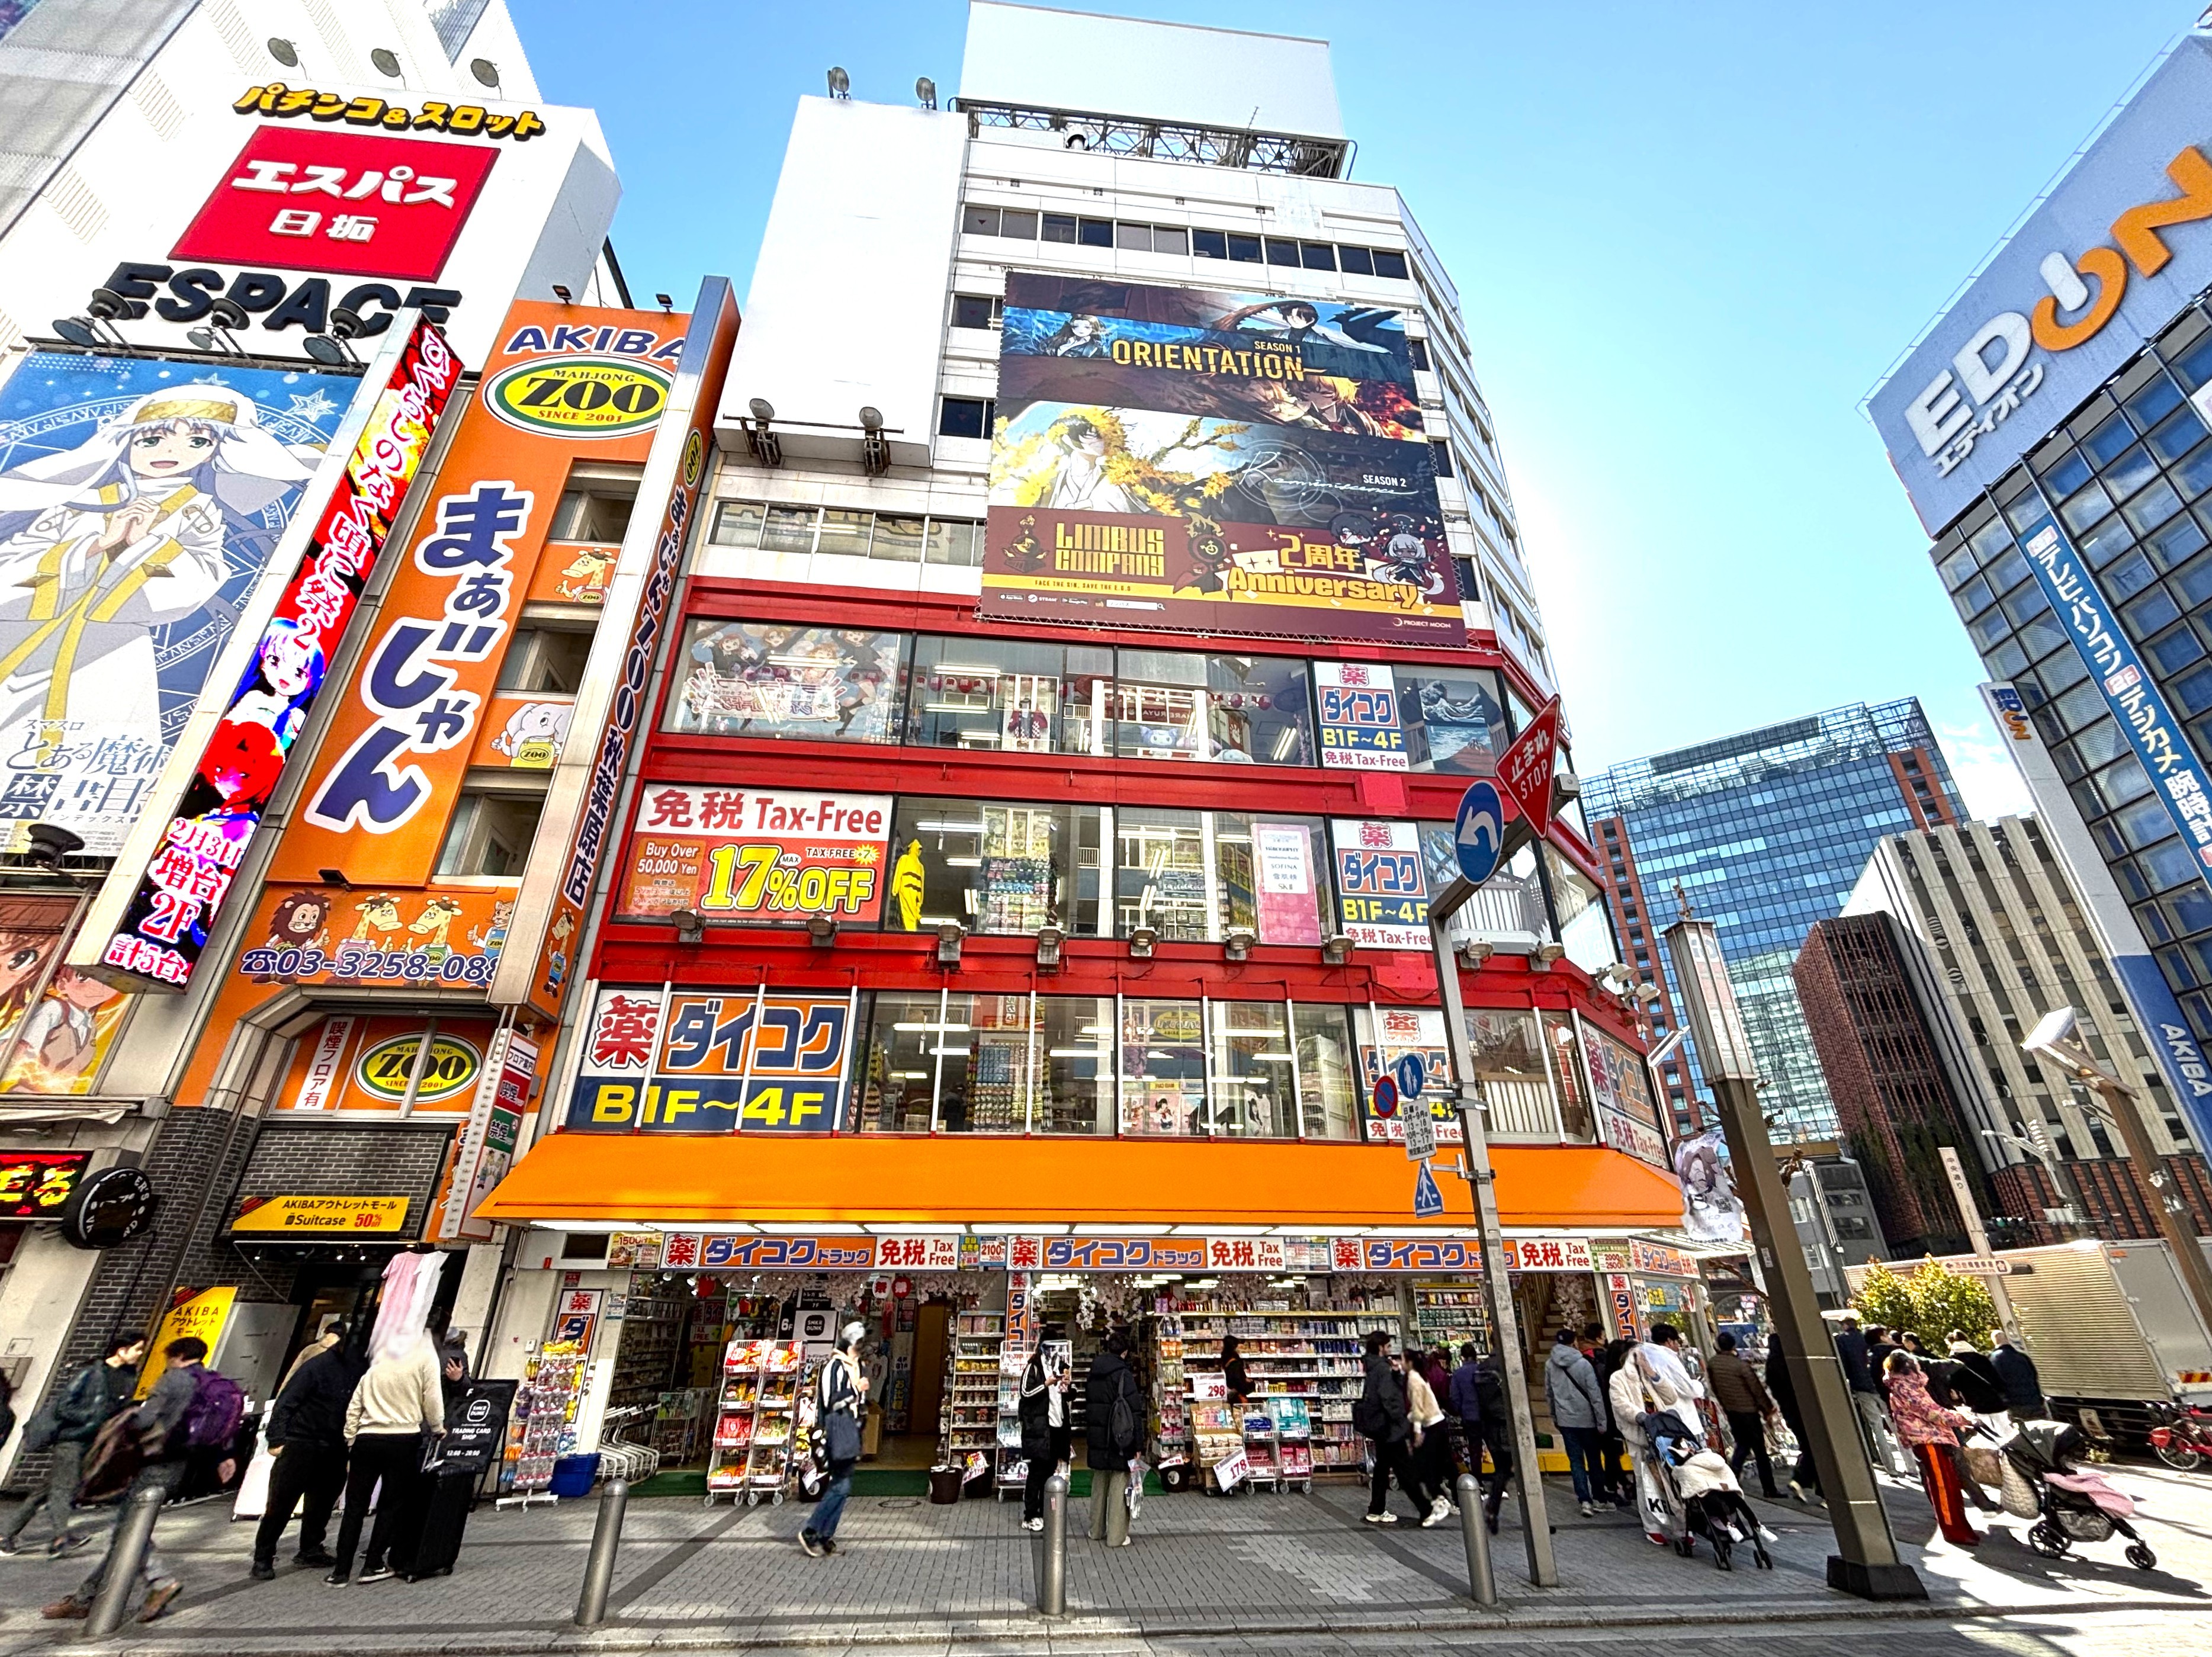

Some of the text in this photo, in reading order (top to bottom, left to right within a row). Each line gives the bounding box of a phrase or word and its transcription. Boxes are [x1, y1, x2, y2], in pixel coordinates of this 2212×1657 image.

[233, 82, 546, 142] パチンコ&スロット
[232, 159, 457, 210] エスパス
[107, 261, 463, 336] ESPACE
[505, 325, 685, 365] AKIBA
[1254, 341, 1301, 354] SEASON 1
[1113, 339, 1304, 381] ORIENTATION
[553, 369, 635, 383] MAHJONG
[518, 377, 660, 413] ZOO
[538, 410, 622, 423] SINCE 2001
[1932, 363, 2043, 478] エディオン
[1363, 474, 1407, 487] SEASON 2
[1056, 522, 1164, 554] LIMBUS
[1055, 549, 1164, 577] COMPANY
[1279, 534, 1362, 571] 2周年
[1228, 567, 1418, 609] Anniversary
[1404, 619, 1428, 628] PROJECT
[314, 486, 526, 824] まぁじゃん
[1339, 663, 1370, 686] 薬
[1324, 689, 1398, 726] ダイコク
[24, 720, 85, 731] スマスロ
[1325, 752, 1406, 767] 免税 Tax-Free
[1511, 728, 1550, 783] 止まれ
[1520, 759, 1548, 799] STOP
[46, 814, 125, 824] インデックス
[647, 789, 882, 833] 免税 Tax-Free
[1360, 821, 1392, 848] 薬
[646, 842, 699, 858] Buy Over
[782, 855, 800, 863] MAX
[805, 847, 855, 859] TAX-FREE
[155, 848, 223, 904] 増台
[637, 859, 697, 875] 50,000 Yen
[1343, 853, 1426, 893] ダイコク
[140, 893, 200, 942] 2F
[592, 995, 660, 1070] 薬
[666, 1000, 848, 1071] ダイコク
[1385, 1011, 1421, 1043] 薬
[396, 1046, 453, 1055] MAHONG
[2160, 1024, 2212, 1097] AKIBA
[303, 1021, 349, 1107] 喫煙フロア有
[374, 1053, 468, 1080] ZOO
[282, 1200, 397, 1210] AKIBAアウトレットモール
[294, 1215, 346, 1225] Suitcase
[667, 1233, 699, 1266] 薬
[879, 1238, 925, 1266] 免税
[933, 1239, 953, 1252] Tax
[1012, 1235, 1039, 1269] 薬
[1212, 1241, 1255, 1267] 免税
[1261, 1241, 1279, 1254] Tax
[1333, 1238, 1361, 1270] 薬
[1521, 1242, 1564, 1267] 免税
[1566, 1242, 1585, 1254] Tax
[929, 1252, 955, 1266] Free
[1258, 1254, 1283, 1267] Free
[1566, 1254, 1590, 1267] Free
[1012, 1274, 1027, 1288] 薬
[1611, 1275, 1627, 1289] 薬
[175, 1306, 219, 1316] AKIBA
[570, 1290, 592, 1312] 薬
[170, 1317, 216, 1327] アウトレット
[176, 1328, 204, 1338] モール
[781, 1318, 794, 1331] 6F
[1208, 1385, 1225, 1398] 298
[1230, 1459, 1247, 1479] 178
